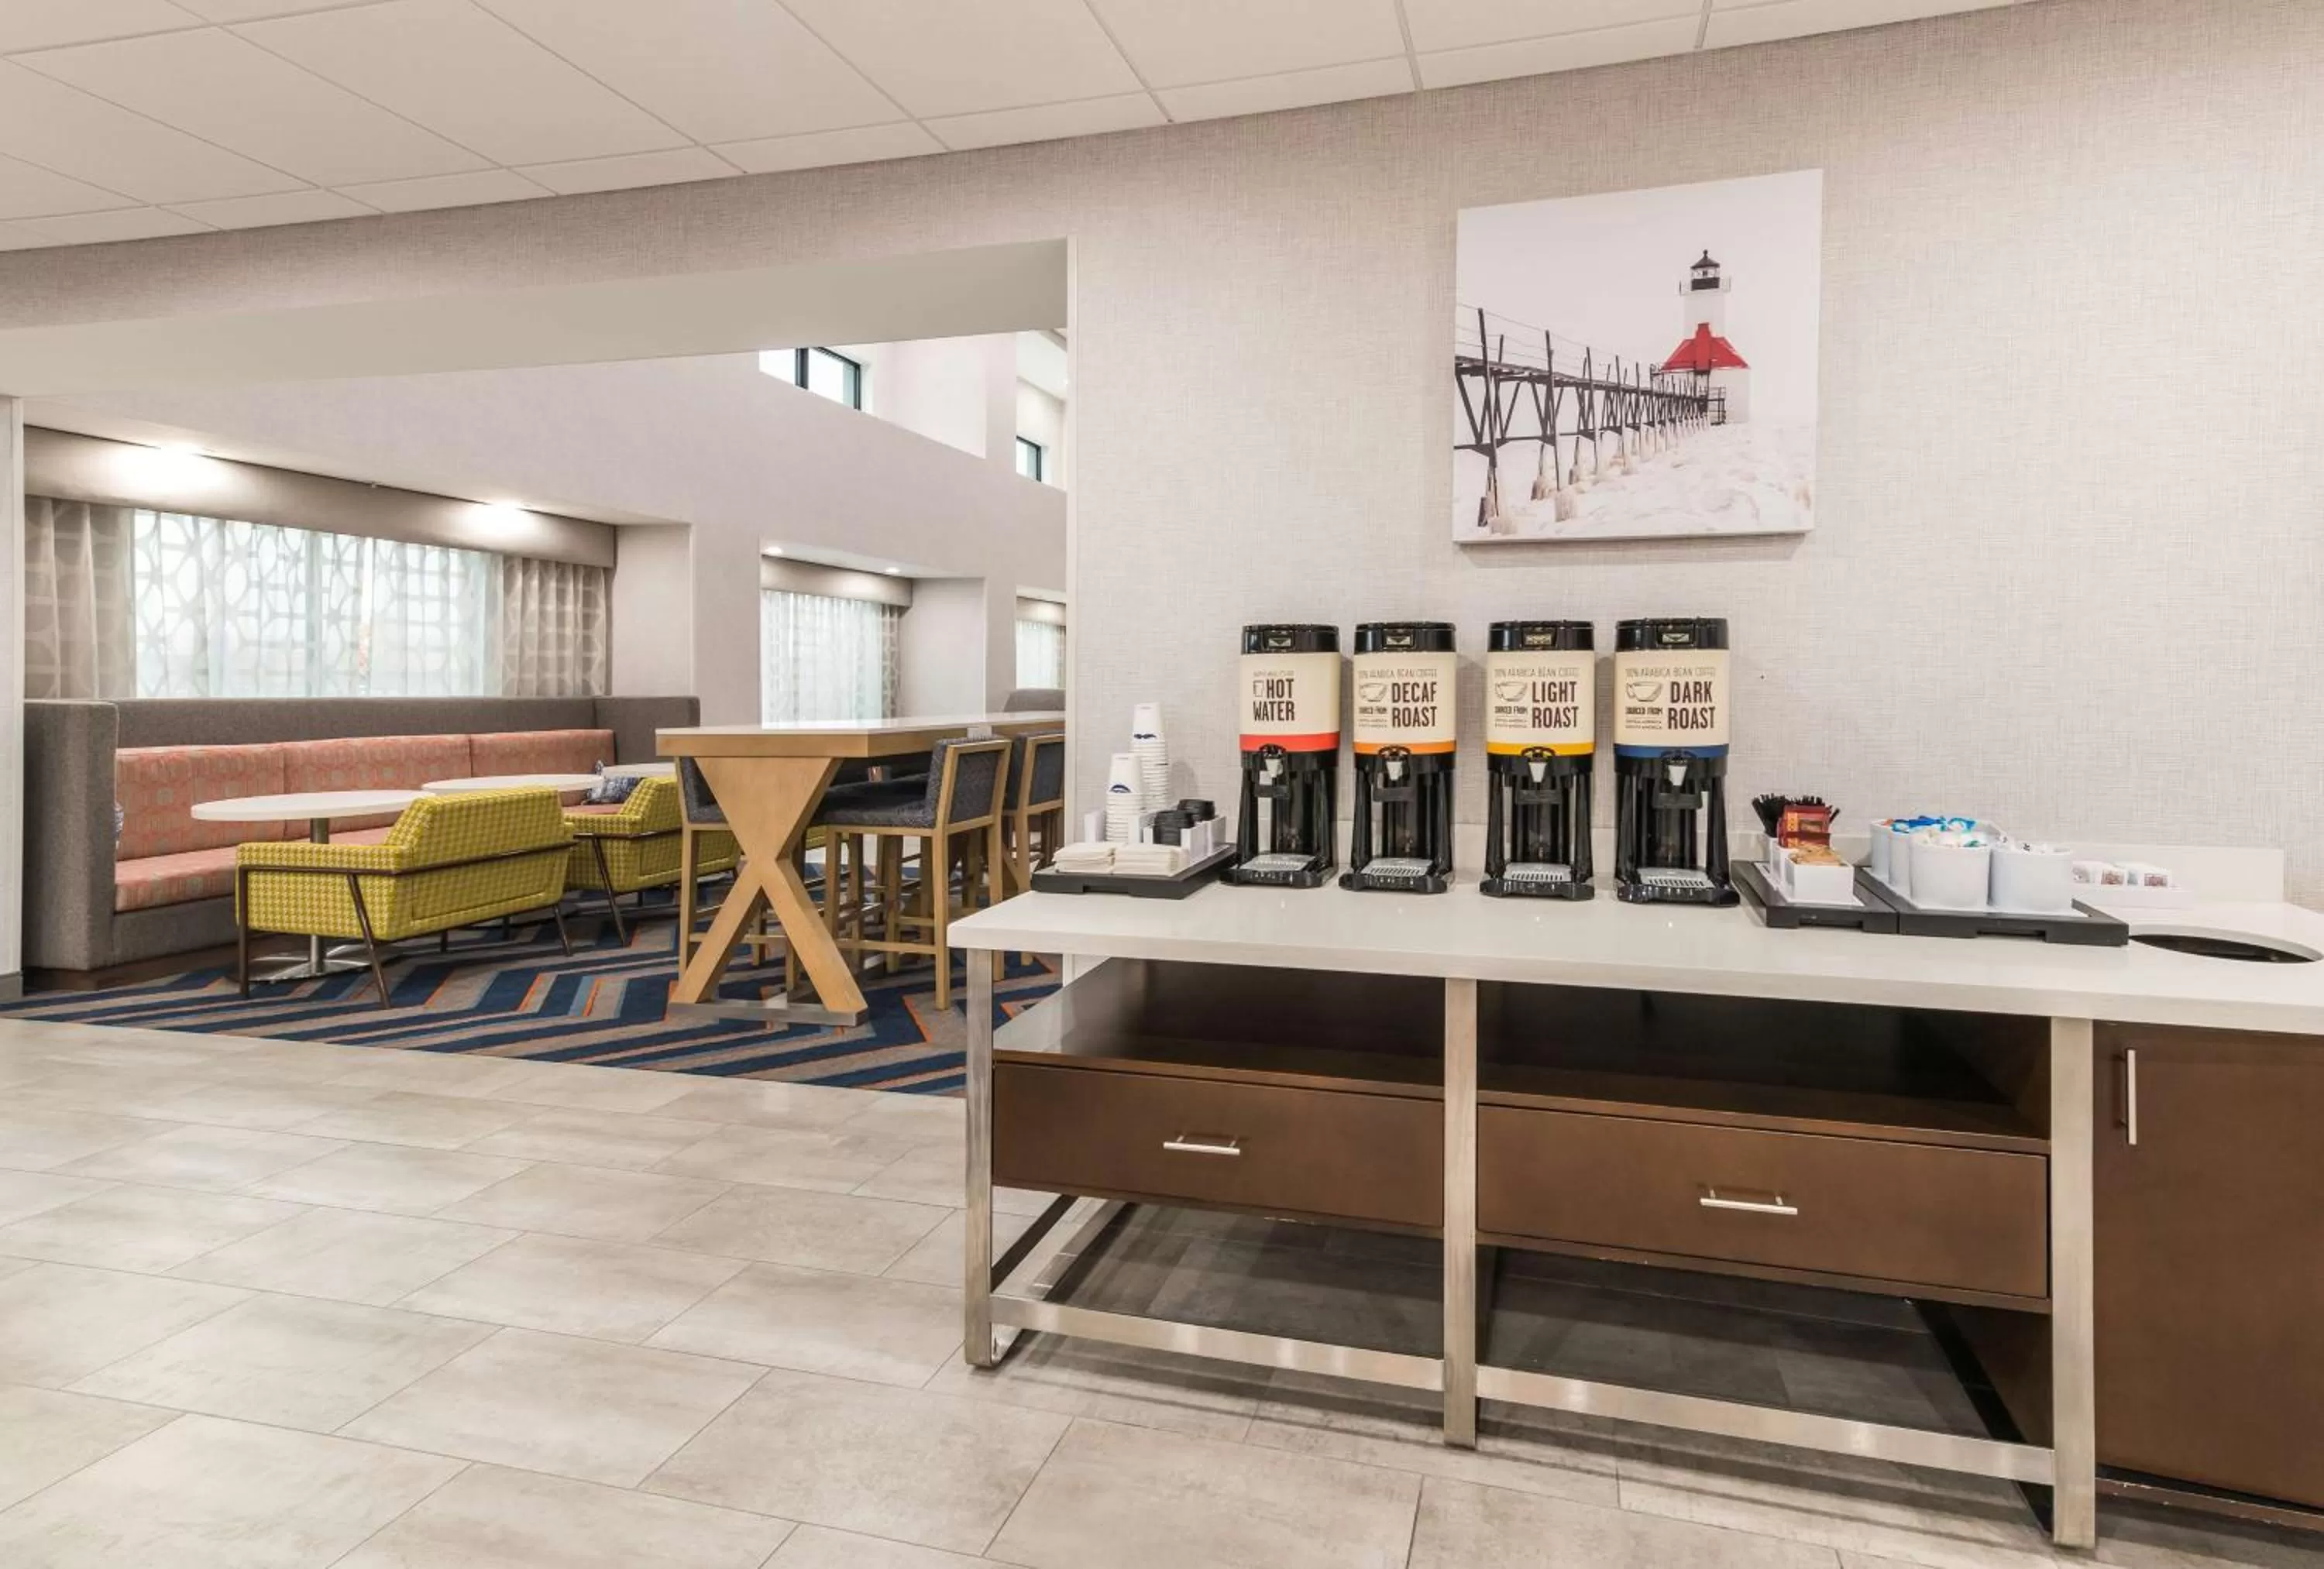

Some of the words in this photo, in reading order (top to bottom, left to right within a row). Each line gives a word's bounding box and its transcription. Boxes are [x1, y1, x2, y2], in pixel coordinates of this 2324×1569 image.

[1267, 678, 1294, 699] HOT
[1392, 682, 1437, 703] DECAF
[1532, 681, 1577, 703] LIGHT
[1670, 681, 1712, 703] DARK
[1253, 700, 1294, 721] WATER
[1392, 706, 1438, 728] ROAST
[1532, 706, 1580, 729] ROAST
[1668, 706, 1716, 730] ROAST
